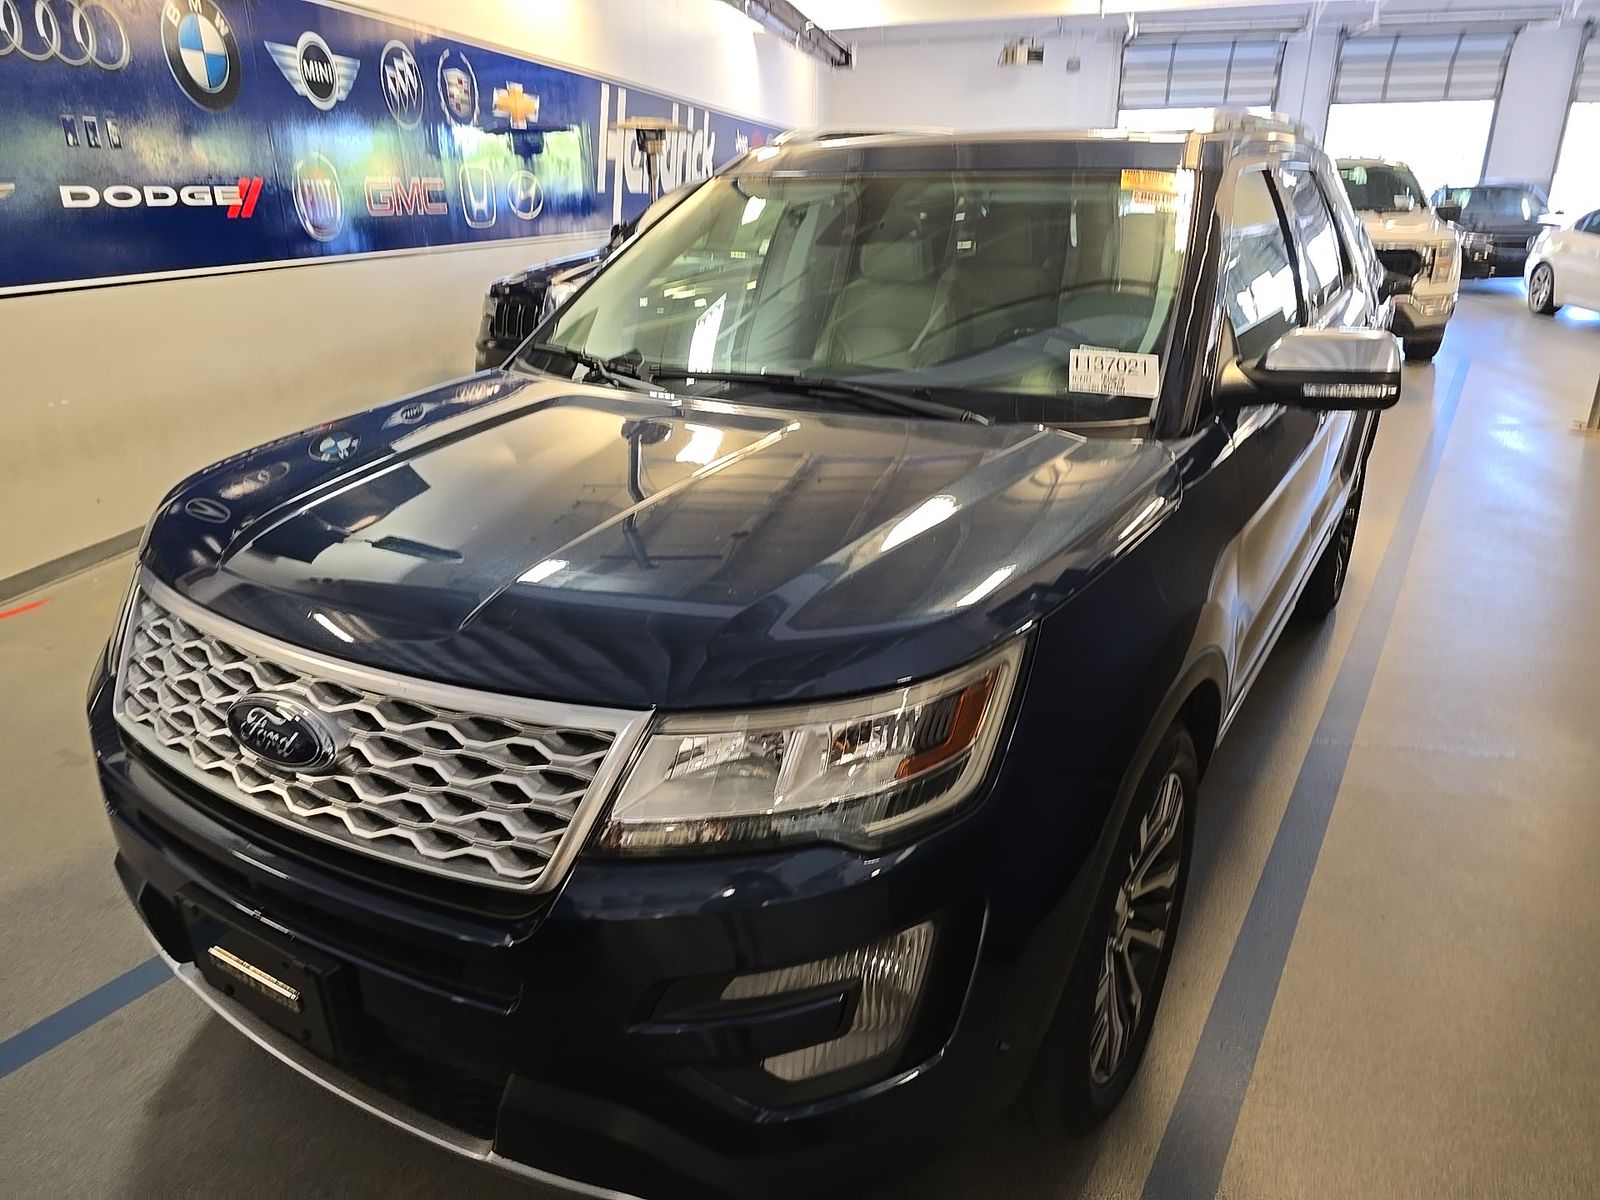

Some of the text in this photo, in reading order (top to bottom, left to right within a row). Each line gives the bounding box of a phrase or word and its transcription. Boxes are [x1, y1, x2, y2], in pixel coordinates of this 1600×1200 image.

[166, 0, 229, 37] BMW
[302, 58, 333, 84] MINI
[59, 185, 243, 208] DODGE
[364, 176, 448, 217] GMC
[240, 706, 299, 758] Ford
